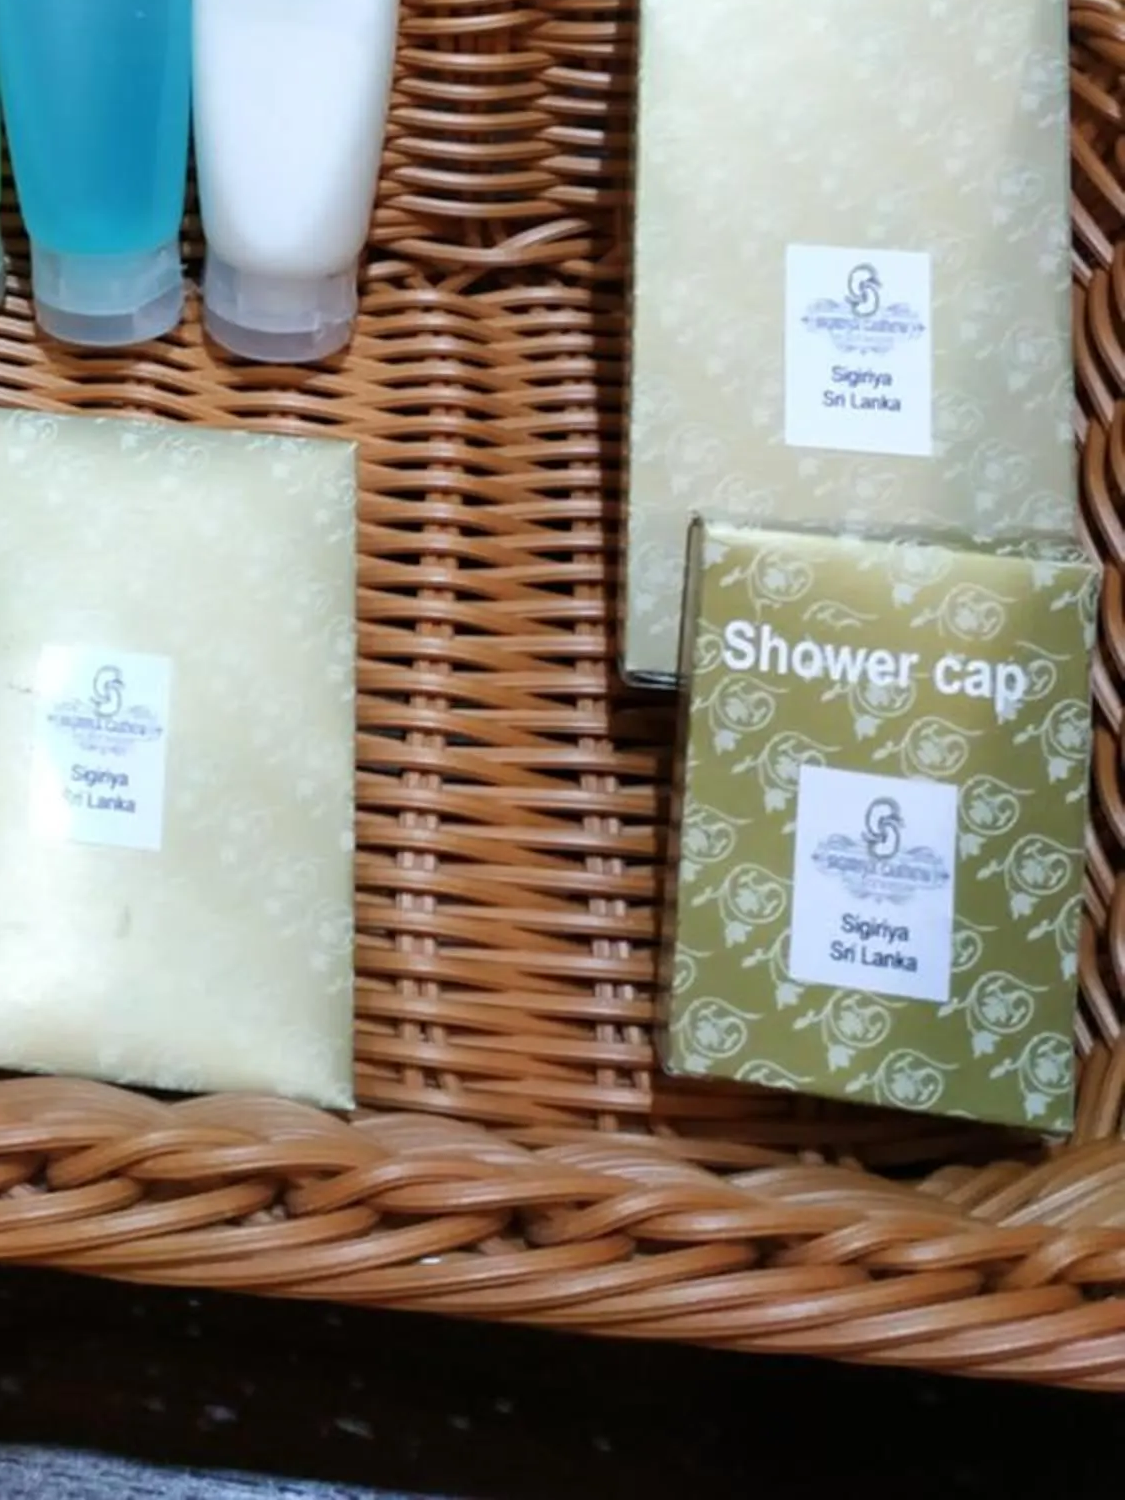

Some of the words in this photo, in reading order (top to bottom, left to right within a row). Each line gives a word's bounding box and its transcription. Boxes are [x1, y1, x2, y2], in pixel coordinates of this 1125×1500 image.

[823, 390, 846, 408] Sri
[851, 393, 902, 412] Lanka
[723, 619, 920, 688] Shower
[933, 654, 1027, 723] cap
[87, 793, 136, 814] Lanka
[841, 912, 910, 944] Sigiriya
[830, 940, 856, 963] Sri
[861, 946, 918, 972] Lanka
